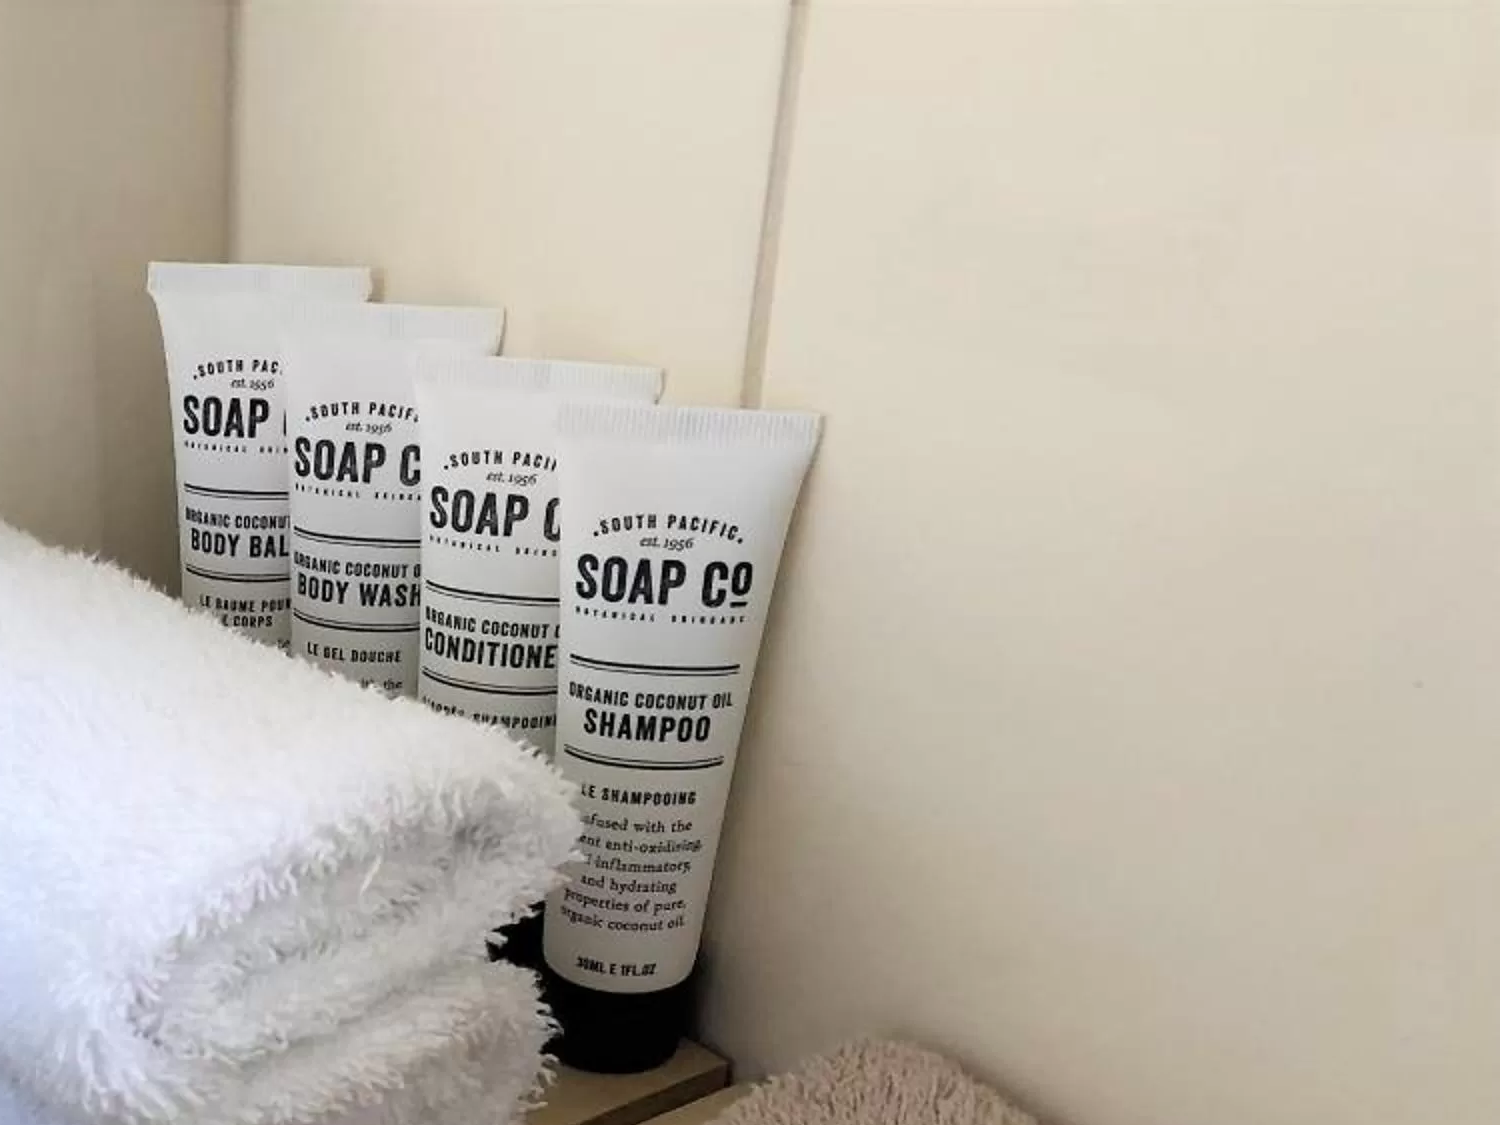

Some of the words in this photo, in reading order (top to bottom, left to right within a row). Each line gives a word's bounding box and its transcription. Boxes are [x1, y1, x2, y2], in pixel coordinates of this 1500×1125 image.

[198, 359, 243, 377] SOUTH
[251, 359, 283, 376] PAC
[183, 395, 269, 438] SOAP
[310, 401, 360, 419] SOUTH
[369, 402, 418, 422] PACIF
[294, 436, 386, 484] SOAP
[400, 444, 420, 486] C
[449, 450, 503, 468] SOUTH
[430, 486, 529, 537] SOAP
[544, 497, 560, 542] C
[600, 514, 657, 535] SOUTH
[668, 514, 739, 541] PACIFIC
[191, 527, 240, 557] BODY
[250, 535, 290, 558] BAL
[663, 537, 694, 551] 1956
[294, 551, 341, 575] ORGANIC
[345, 562, 408, 579] COCONUT
[298, 572, 349, 604] BODY
[359, 583, 421, 607] WASH
[576, 553, 687, 605] SOAP
[233, 615, 273, 629] CORPS
[426, 605, 476, 632] ORGANIC
[481, 619, 550, 639] COCONUT
[307, 642, 319, 656] LE
[323, 646, 345, 661] GEL
[350, 650, 402, 663] DOUCHE
[425, 627, 559, 669] CONDITIONE
[569, 681, 629, 707] ORGANIC
[634, 692, 708, 711] COCONUT
[711, 692, 733, 708] OIL
[583, 708, 711, 742] SHAMPOO
[601, 787, 697, 806] SHAMPOOING
[633, 820, 665, 833] with
[670, 820, 693, 832] the
[580, 875, 605, 888] and
[610, 877, 677, 895] hydrating
[634, 899, 649, 913] of
[607, 921, 664, 931] coconut
